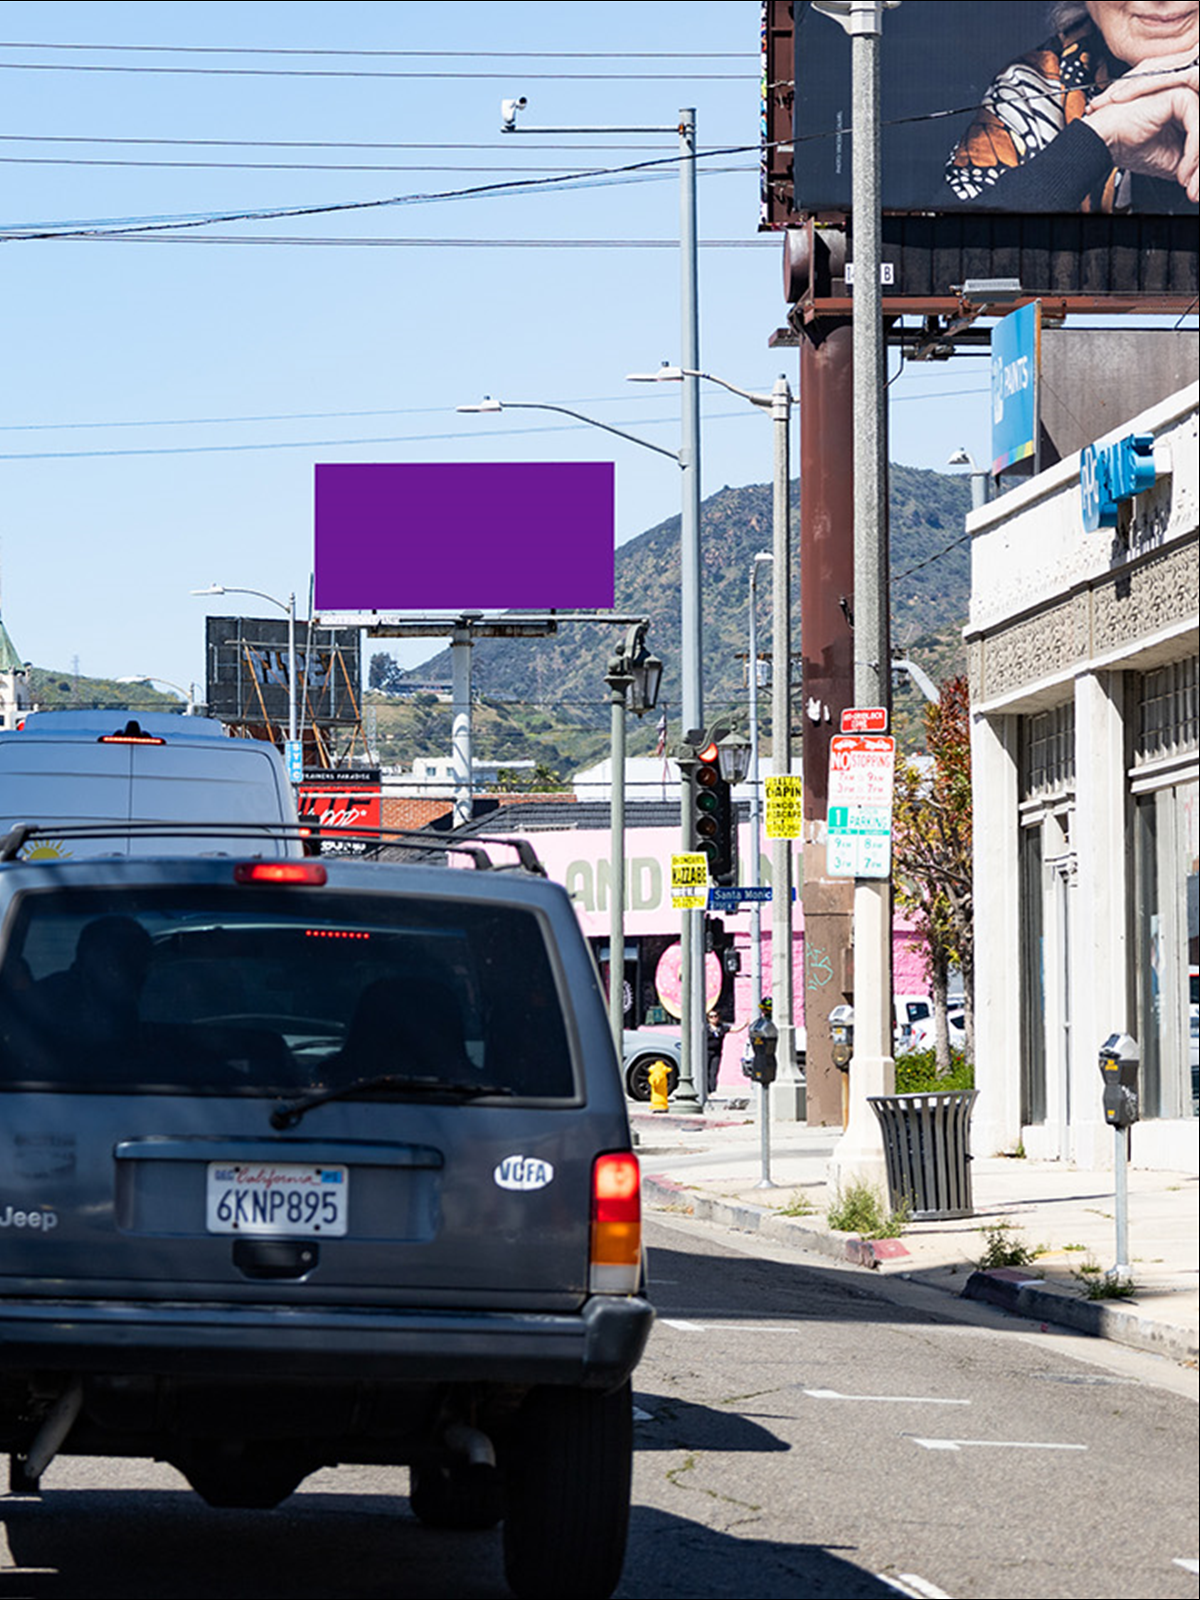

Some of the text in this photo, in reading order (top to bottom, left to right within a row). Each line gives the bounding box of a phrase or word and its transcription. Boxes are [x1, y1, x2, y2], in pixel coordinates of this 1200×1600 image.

[884, 265, 891, 281] B
[831, 749, 891, 771] NO STOPPING
[836, 809, 841, 826] 1
[850, 814, 888, 829] PARKING
[538, 857, 663, 912] AND
[714, 889, 742, 900] Santa
[744, 889, 772, 900] Monic
[237, 1166, 322, 1189] California
[500, 1161, 547, 1182] VCFA
[216, 1188, 338, 1224] 6KNP895
